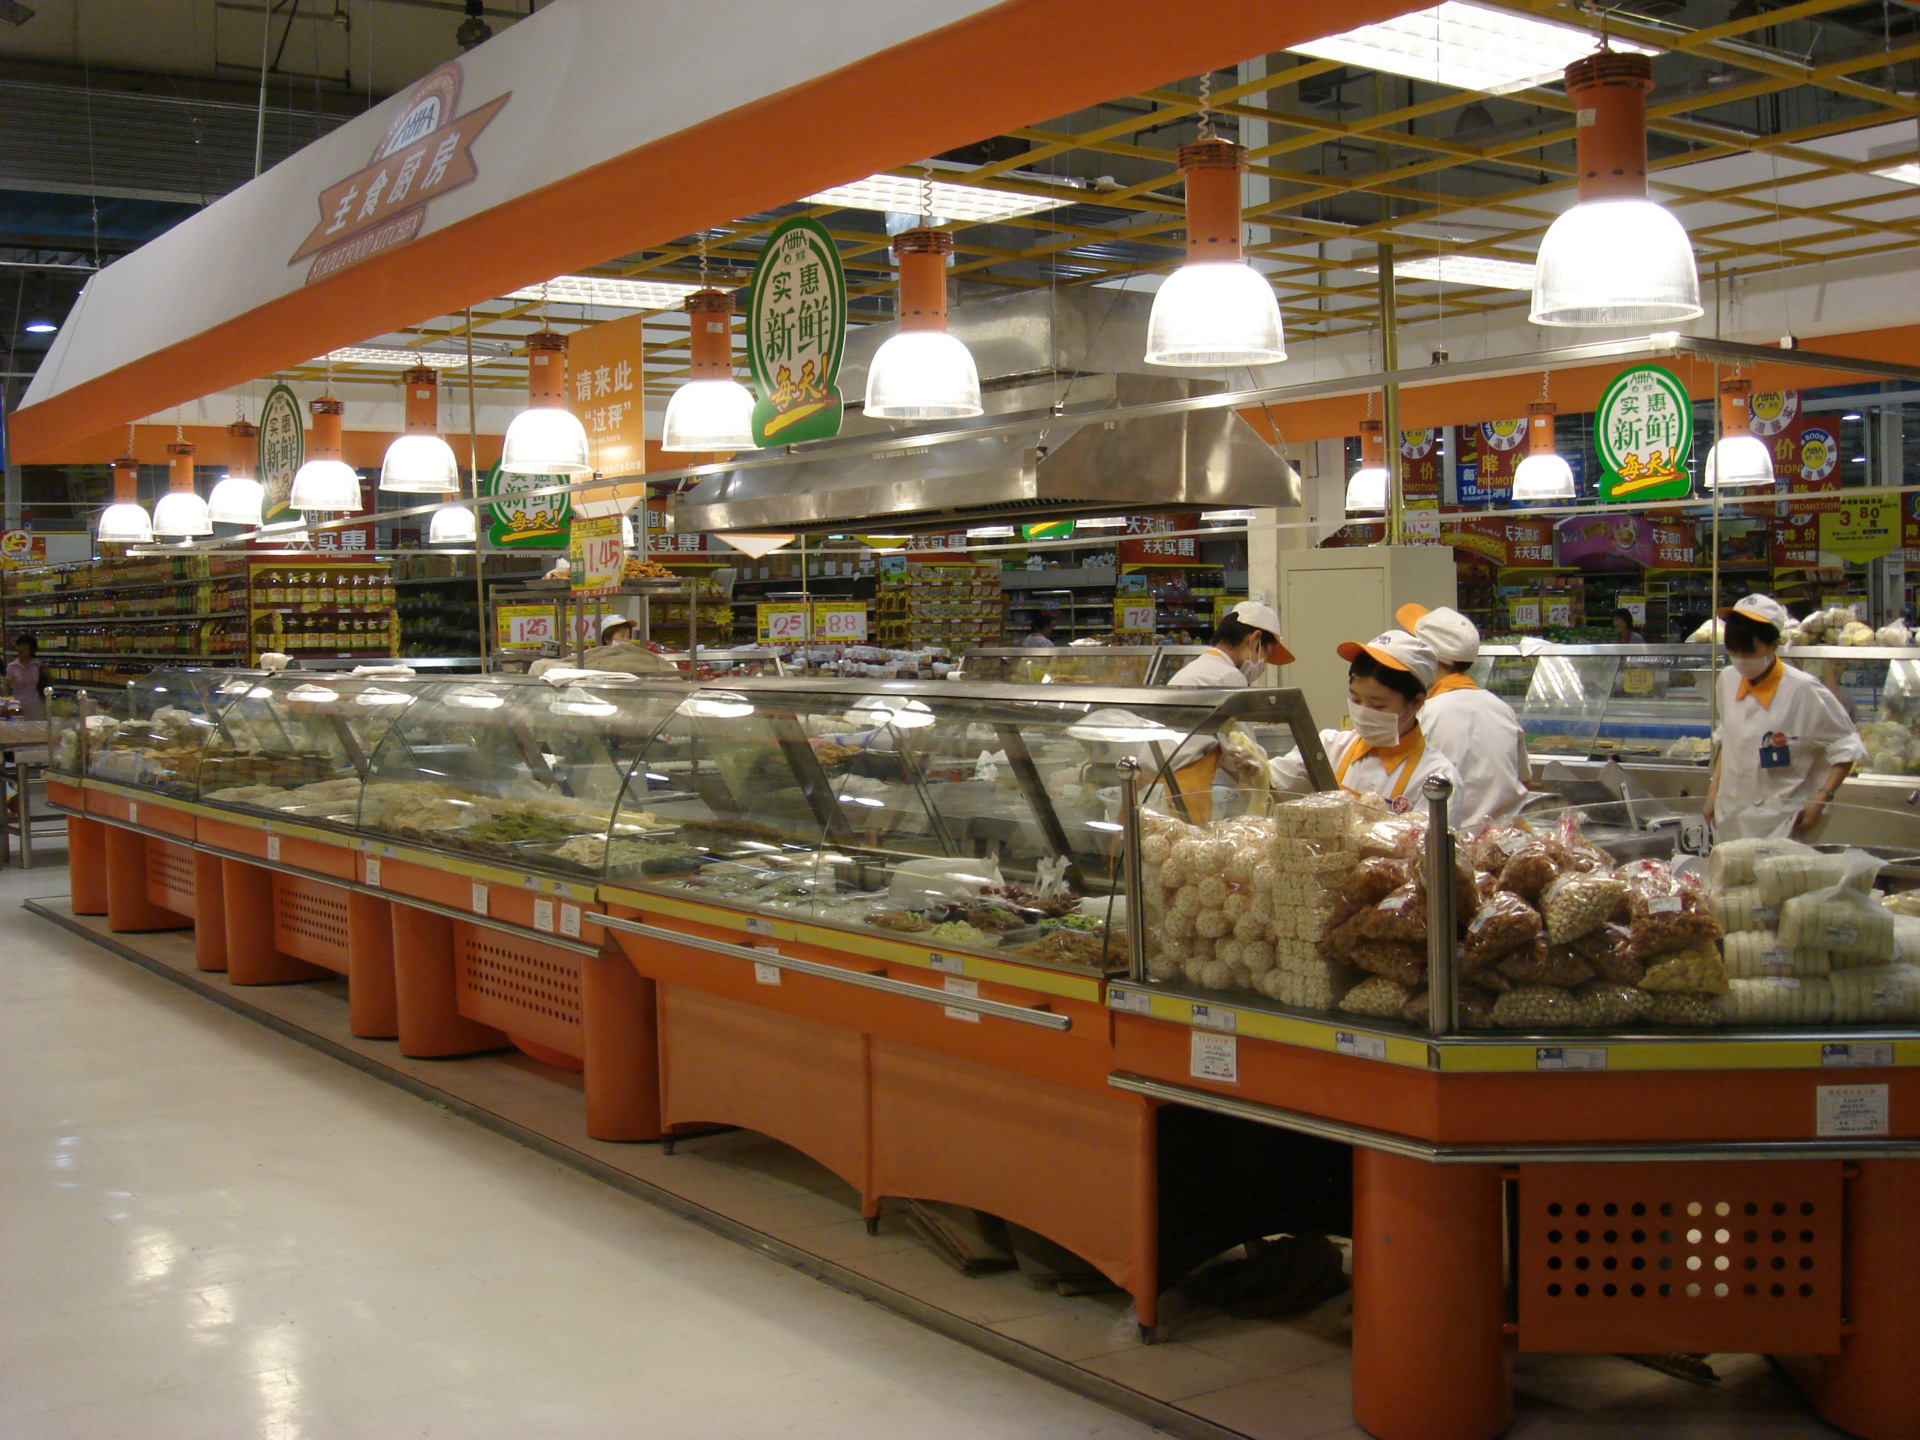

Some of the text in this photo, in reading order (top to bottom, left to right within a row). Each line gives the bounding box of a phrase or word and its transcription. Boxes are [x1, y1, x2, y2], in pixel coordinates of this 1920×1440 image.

[325, 132, 461, 236] 主食厨房
[772, 262, 819, 304] 实惠
[764, 295, 829, 363] 新鲜
[575, 360, 633, 402] 请来此
[1620, 393, 1667, 415] 实惠
[270, 414, 291, 437] 实惠
[1612, 413, 1677, 451] 新鲜
[266, 434, 297, 474] 新鲜
[1789, 501, 1841, 511] PROMOTION
[588, 538, 621, 574] 1.45
[1142, 538, 1196, 557] 天天实惠
[519, 618, 548, 642] 1.25
[773, 615, 803, 636] 2.5
[828, 614, 858, 634] 8.8
